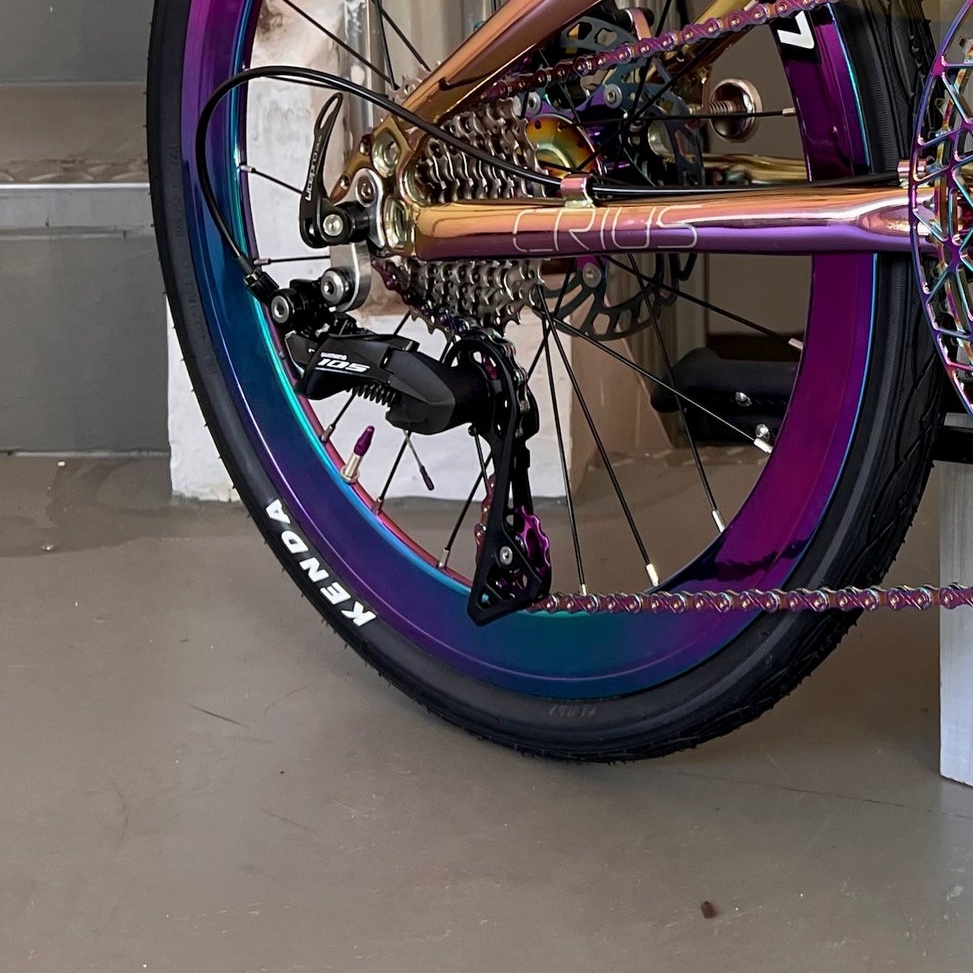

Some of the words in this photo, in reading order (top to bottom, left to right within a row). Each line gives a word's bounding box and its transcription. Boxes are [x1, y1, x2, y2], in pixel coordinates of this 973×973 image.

[512, 205, 703, 253] CRIUS
[317, 358, 371, 373] 105
[265, 498, 377, 627] KENDA
